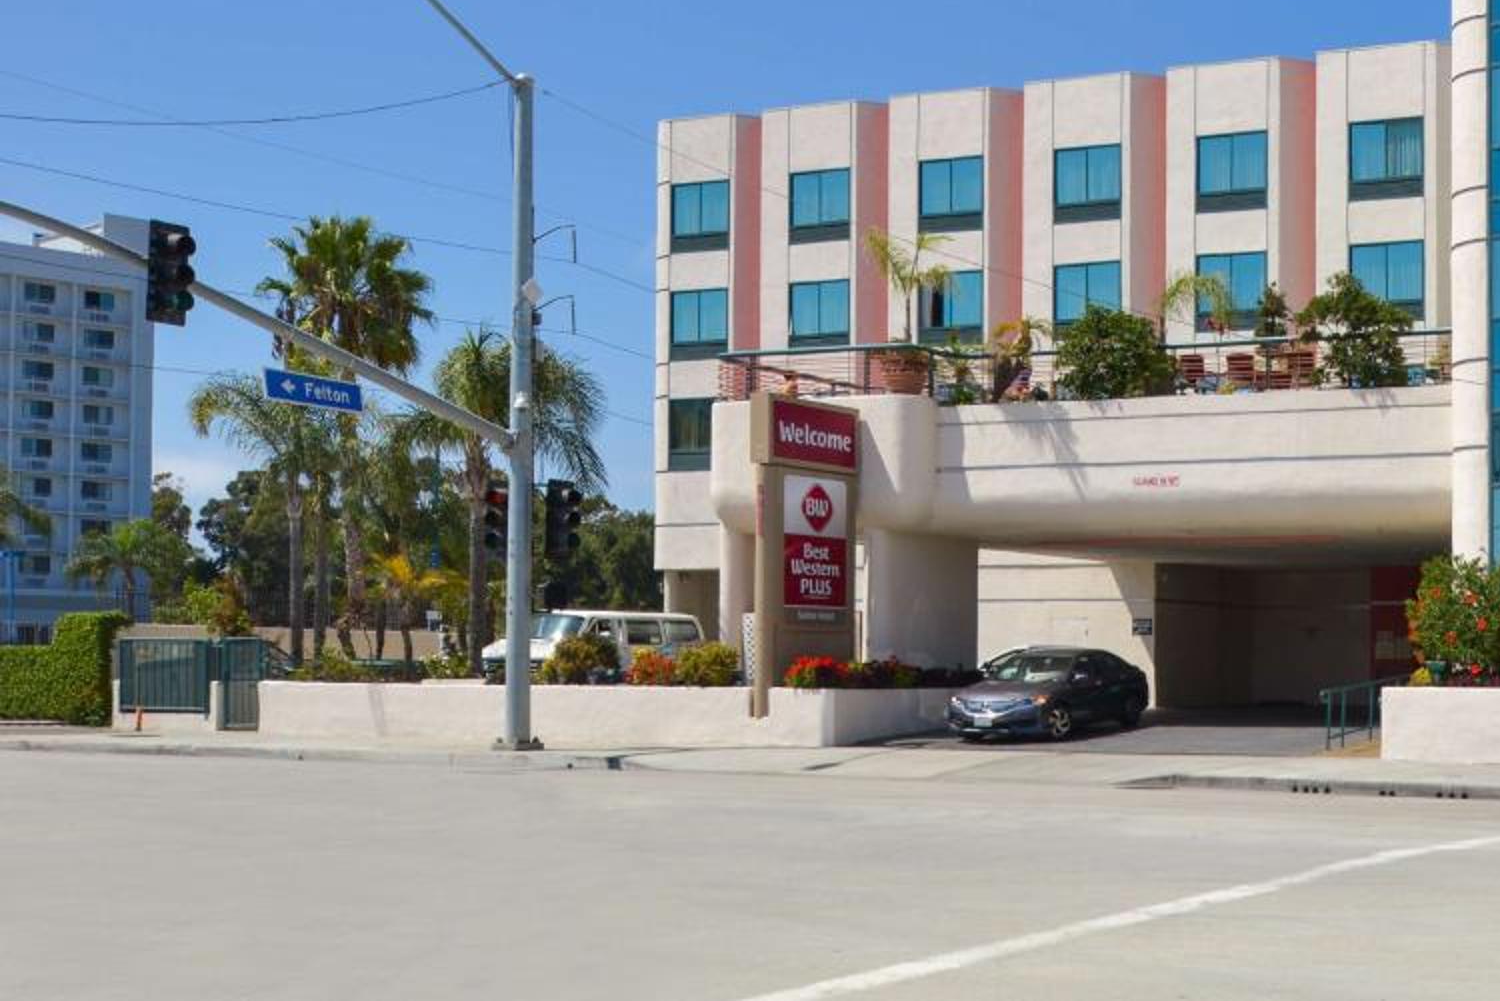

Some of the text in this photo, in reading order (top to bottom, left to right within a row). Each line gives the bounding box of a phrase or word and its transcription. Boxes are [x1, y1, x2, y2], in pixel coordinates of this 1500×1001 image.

[304, 382, 351, 404] Felton
[779, 420, 852, 453] Welcome
[803, 543, 830, 560] Best
[791, 559, 840, 577] Western
[801, 579, 833, 596] PLUS
